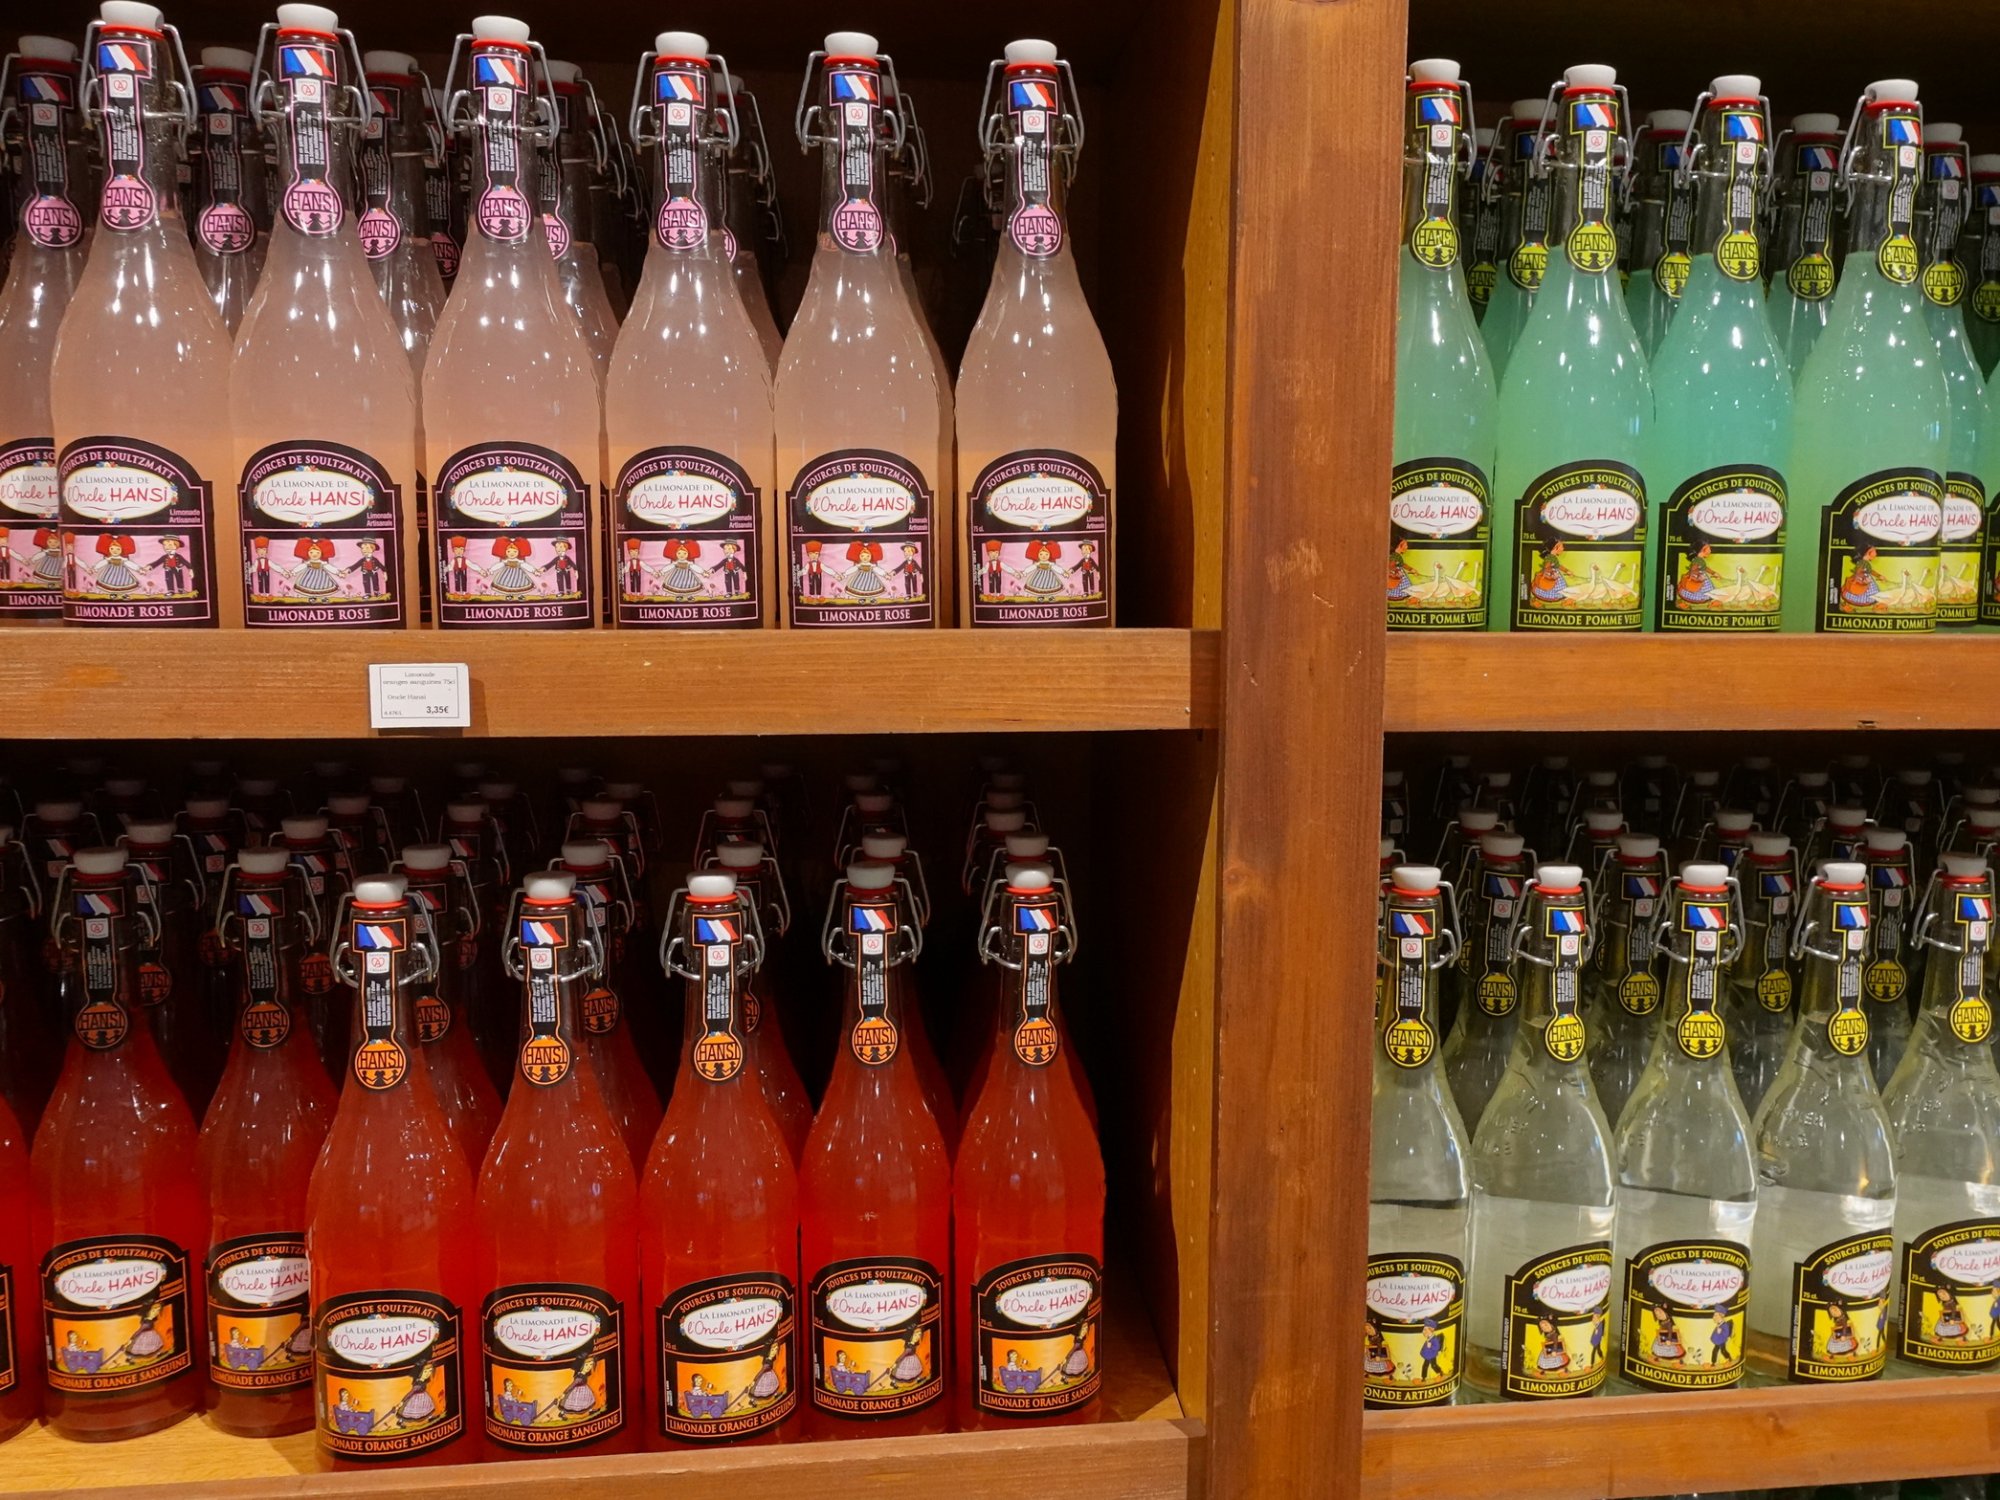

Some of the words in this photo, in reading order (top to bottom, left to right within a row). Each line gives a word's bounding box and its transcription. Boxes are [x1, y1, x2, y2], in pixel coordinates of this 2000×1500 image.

[106, 188, 147, 208] HANSI
[290, 191, 335, 212] HANSI
[484, 199, 524, 217] HANSI
[33, 208, 78, 227] HANSI
[207, 215, 250, 233] HANSI
[840, 212, 879, 230] HANSI
[1018, 217, 1057, 234] HANSI
[363, 220, 396, 239] HANSI
[1575, 234, 1614, 251] HANSI
[1724, 242, 1759, 260] HANSI
[1516, 253, 1547, 269] HANS
[1662, 262, 1690, 279] HANS
[1795, 264, 1831, 282] HANSI
[1926, 271, 1963, 288] HANSI
[252, 457, 285, 482] SOURCES
[289, 455, 302, 464] DE
[305, 455, 372, 483] SOULTZMATT
[986, 468, 1020, 490] SOURCES
[1023, 464, 1036, 472] DE
[1038, 463, 1092, 487] SOULTZMATT
[272, 479, 280, 487] LA
[283, 479, 331, 488] LIMONADE
[335, 480, 348, 488] DE
[1542, 477, 1580, 498] SOURCES
[68, 486, 106, 503] l'Oncle
[111, 487, 168, 502] HANSI
[260, 488, 305, 506] l'Oncle
[310, 492, 365, 507] HANSI
[458, 491, 503, 507] l'Oncle
[508, 493, 559, 506] HANSI
[632, 495, 675, 509] l'Oncle
[678, 495, 728, 508] HANSI
[813, 497, 859, 512] l'Oncle
[863, 498, 908, 511] HANSI
[994, 497, 1038, 512] l'Oncle
[1042, 496, 1086, 510] HANSI
[1393, 504, 1438, 519] l'Oncle
[1549, 506, 1594, 520] l'Oncle
[1696, 510, 1742, 524] l'Oncle
[1862, 512, 1907, 528] l'Oncle
[9, 593, 62, 605] LIMONAD
[76, 606, 134, 618] LIMONADE
[139, 605, 173, 617] ROSE
[268, 609, 335, 621] LIMONADE
[339, 608, 370, 620] ROSE
[465, 608, 530, 619] LIMONADE
[534, 606, 563, 617] ROSE
[639, 607, 699, 619] LIMONADE
[703, 607, 731, 617] ROSE
[819, 610, 880, 622] LIMONADE
[885, 609, 910, 620] ROSE
[999, 608, 1058, 619] LIMONADE
[1063, 606, 1087, 617] ROSE
[1388, 613, 1428, 624] ONADE
[1430, 614, 1466, 624] POMME
[1524, 613, 1582, 624] LIMONADE
[1586, 614, 1622, 625] POMME
[1669, 614, 1728, 626] LIMONADE
[1732, 616, 1768, 627] POMME
[1832, 617, 1892, 629] LIMONADE
[1896, 617, 1926, 629] POMME
[426, 706, 448, 714] 3,35€
[1869, 969, 1904, 984] HANSI
[1480, 982, 1516, 998] HANSI
[1623, 980, 1656, 998] HANSI
[81, 1012, 123, 1029] HANSI
[247, 1012, 286, 1029] HANSI
[1956, 1008, 1988, 1023] HANSI
[1552, 1024, 1582, 1043] HANSI
[1684, 1023, 1721, 1038] HANSI
[1835, 1019, 1866, 1036] HANSI
[855, 1029, 895, 1046] HANSI
[1020, 1028, 1056, 1046] HANSI
[1391, 1029, 1428, 1046] HANSI
[359, 1051, 403, 1069] HANSI
[525, 1046, 568, 1064] HANSI
[699, 1044, 740, 1062] HANSI
[1939, 1256, 1981, 1270] l'Oncle
[62, 1281, 105, 1293] l'Oncle
[108, 1269, 159, 1291] HANSI
[225, 1278, 266, 1291] l'Oncle
[271, 1269, 310, 1288] HANS
[1656, 1273, 1699, 1291] l'Oncle
[1831, 1272, 1870, 1285] l'Oncle
[1542, 1282, 1582, 1298] l'Oncle
[493, 1300, 524, 1316] SOURCES
[540, 1297, 600, 1313] SOULTZMATT
[832, 1298, 874, 1313] l'Oncle
[877, 1294, 920, 1313] HANSI
[1004, 1298, 1048, 1312] l'Oncle
[1050, 1288, 1088, 1310] HANSI
[688, 1319, 732, 1334] l'Oncle
[736, 1308, 778, 1331] HANSI
[334, 1335, 378, 1351] l'Oncle
[381, 1326, 432, 1349] HANSI
[500, 1325, 541, 1342] l'Oncle
[544, 1320, 593, 1340] HANSI
[1918, 1346, 1972, 1359] LIMONADE
[94, 1376, 137, 1388] ORANGE
[140, 1358, 186, 1381] SANGUINE
[214, 1370, 252, 1384] LIMONADE
[256, 1374, 295, 1384] ORANGE
[1636, 1363, 1691, 1384] LIMONADE
[1811, 1364, 1864, 1376] LIMONADE
[1520, 1379, 1575, 1391] LIMONADE
[818, 1393, 859, 1409] LIMONADE
[861, 1398, 900, 1409] ORANGE
[902, 1382, 940, 1404] SANGUINE
[984, 1394, 1030, 1408] LIMONADE
[1032, 1397, 1069, 1408] ORANGE
[1365, 1390, 1401, 1400] ONADE
[488, 1422, 526, 1441] LIMONADE
[528, 1429, 570, 1442] ORANGE
[572, 1415, 617, 1437] SANGUINE
[670, 1420, 716, 1433] LIMONADE
[720, 1418, 758, 1432] ORANGE
[365, 1437, 408, 1451] ORANGE
[411, 1419, 458, 1446] SANGUINE
